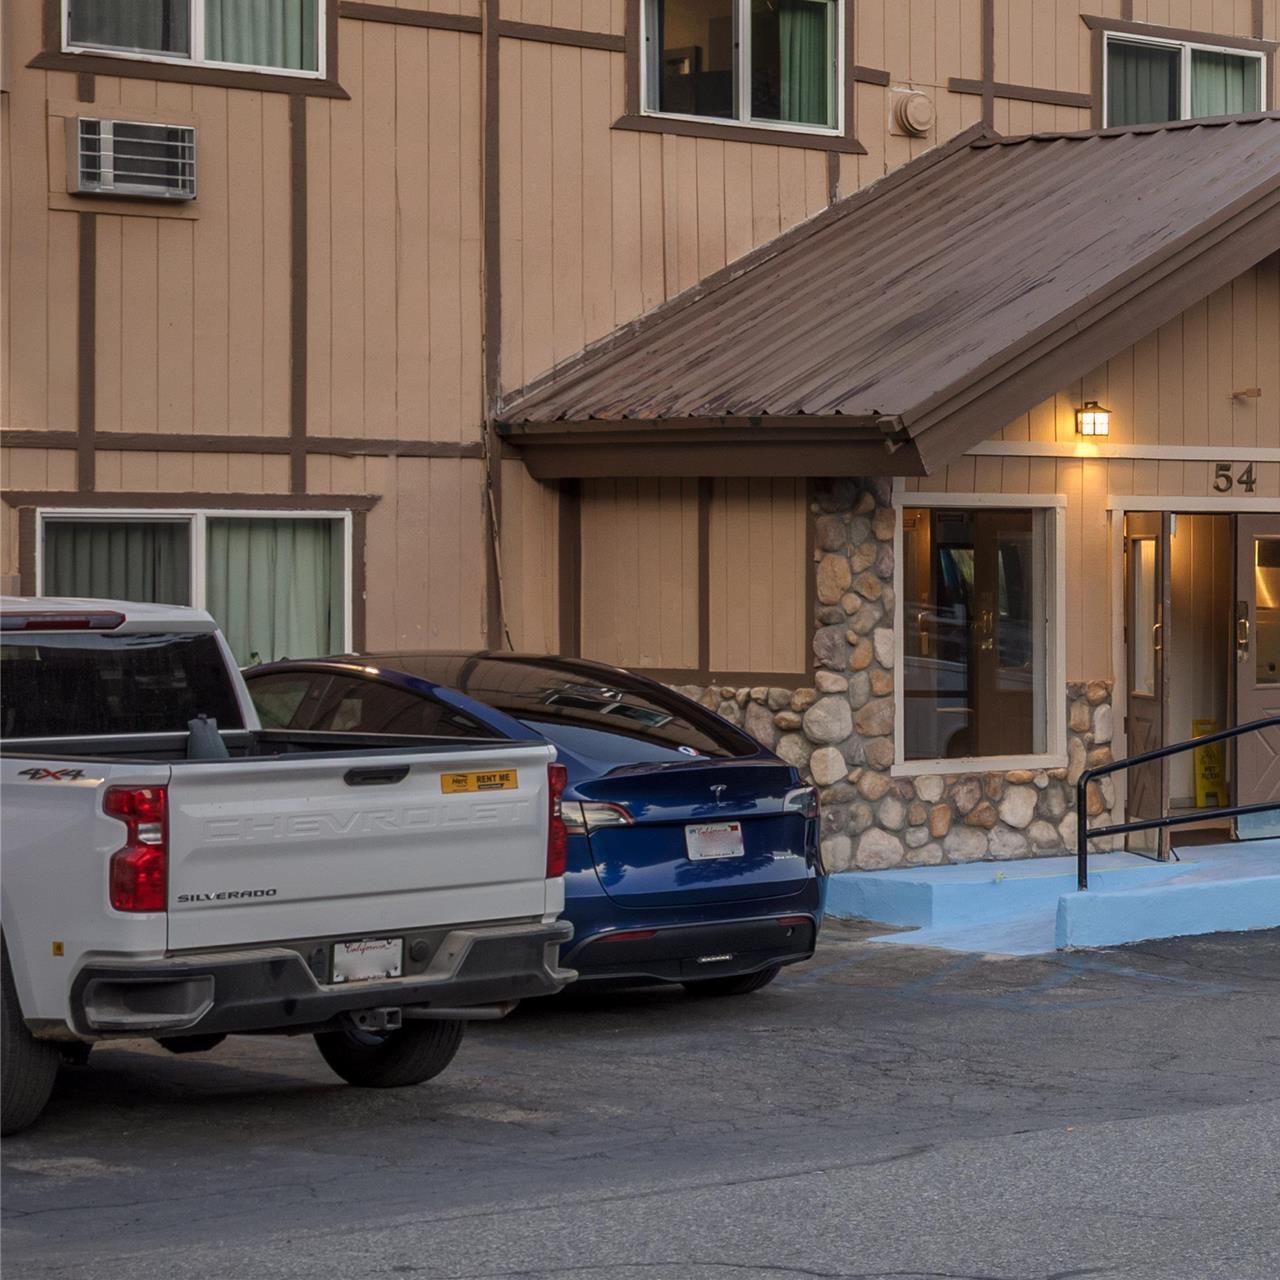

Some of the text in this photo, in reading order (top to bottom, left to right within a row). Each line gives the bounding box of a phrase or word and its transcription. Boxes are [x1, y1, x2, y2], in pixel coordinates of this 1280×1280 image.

[1213, 463, 1257, 493] 54
[476, 774, 497, 784] RENT
[499, 773, 511, 782] ME
[205, 800, 530, 842] CHEVROLET
[177, 888, 277, 903] SILVERADO
